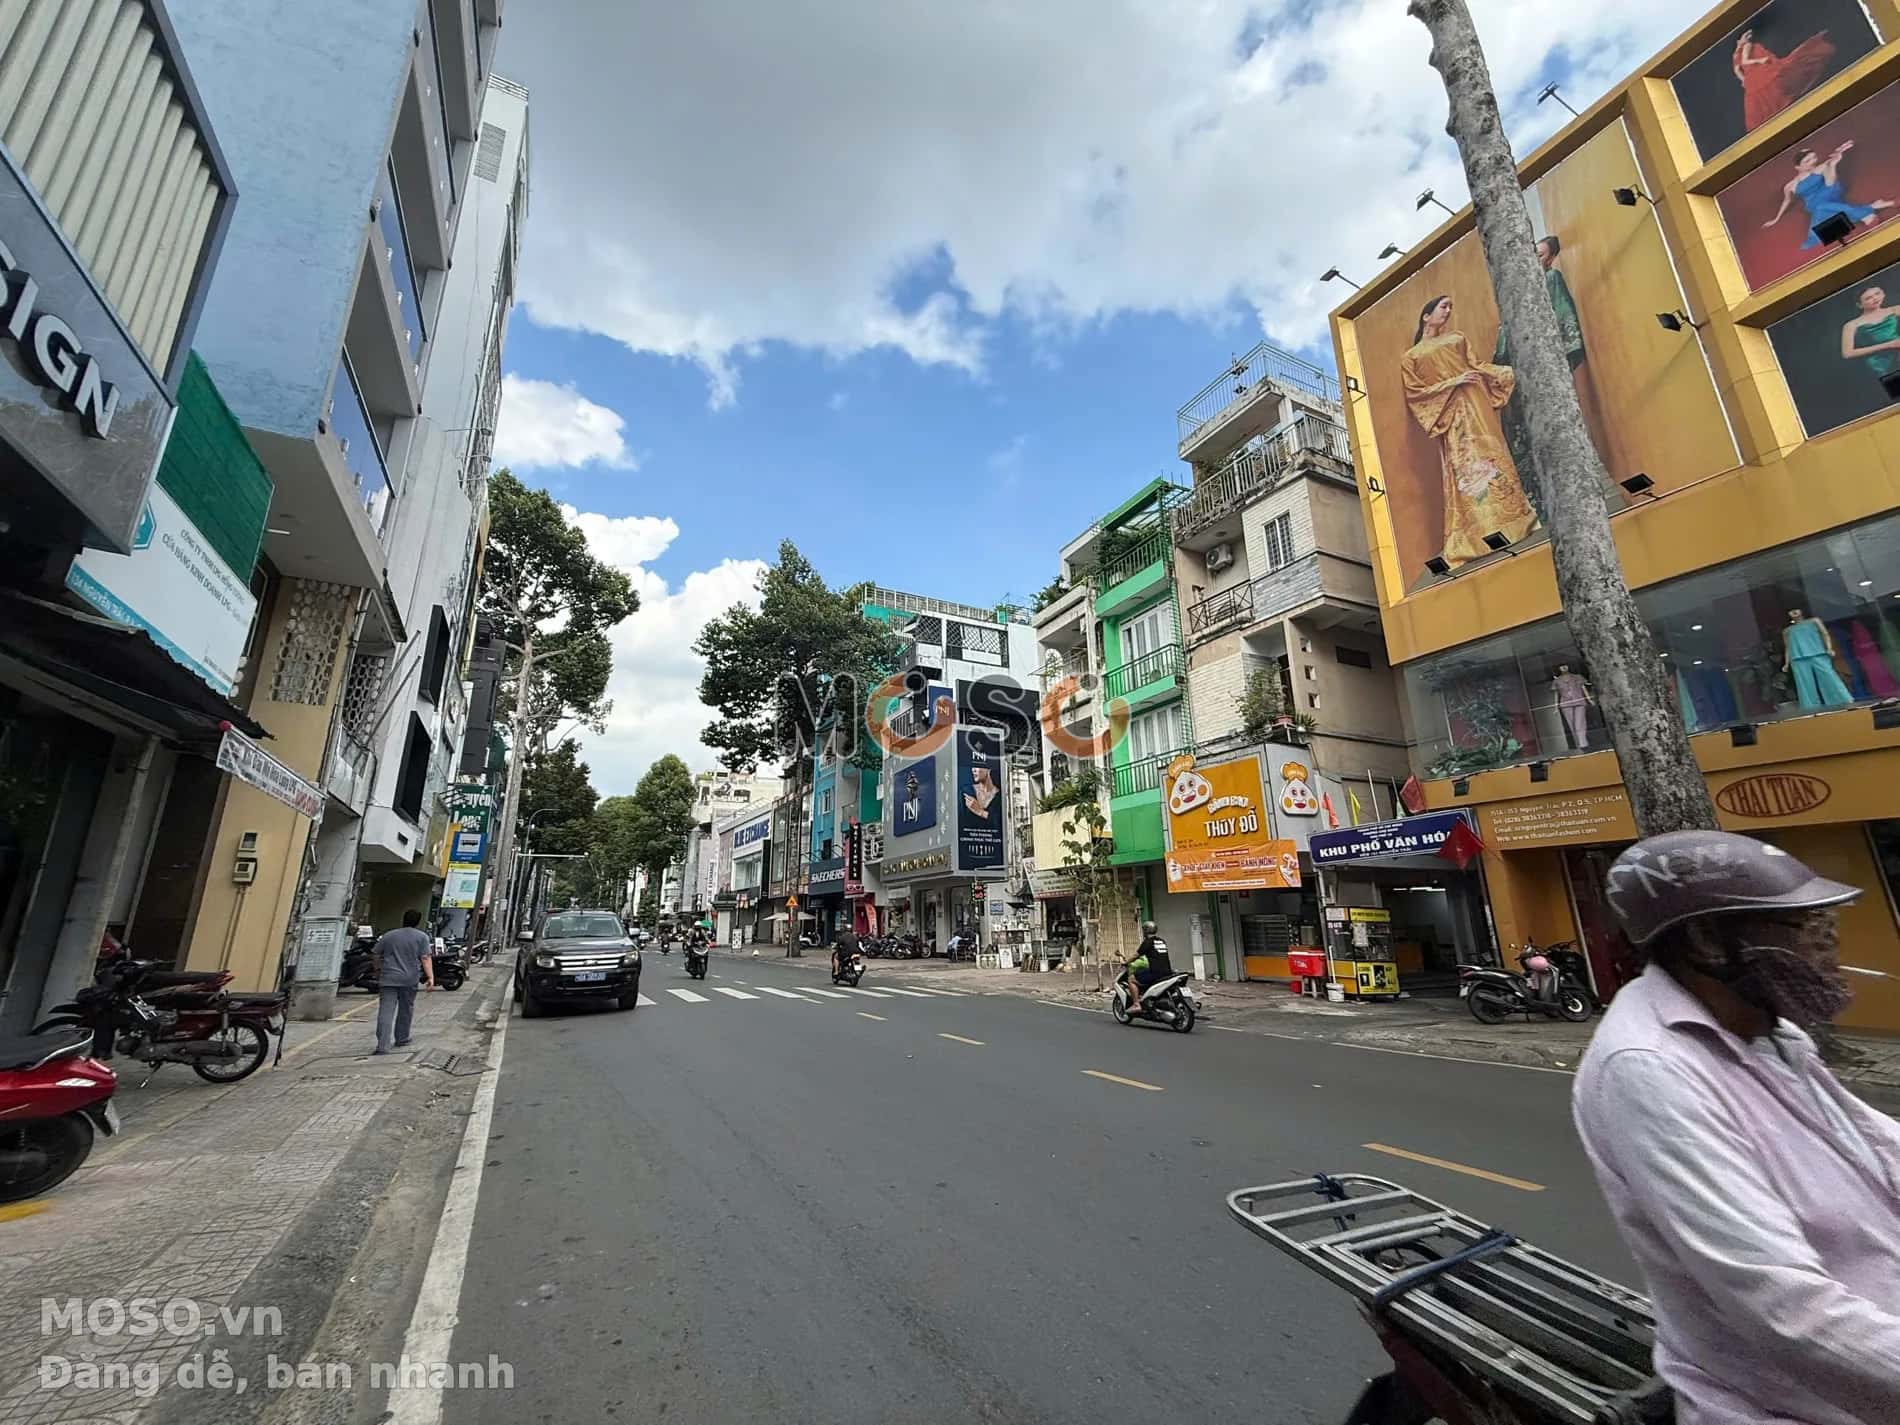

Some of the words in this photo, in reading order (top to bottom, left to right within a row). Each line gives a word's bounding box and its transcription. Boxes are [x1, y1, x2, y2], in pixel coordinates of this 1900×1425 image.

[903, 799, 920, 822] PNJ
[1319, 845, 1347, 858] KHU
[1350, 838, 1381, 855] PHỐ
[810, 868, 847, 883] SKECHERS
